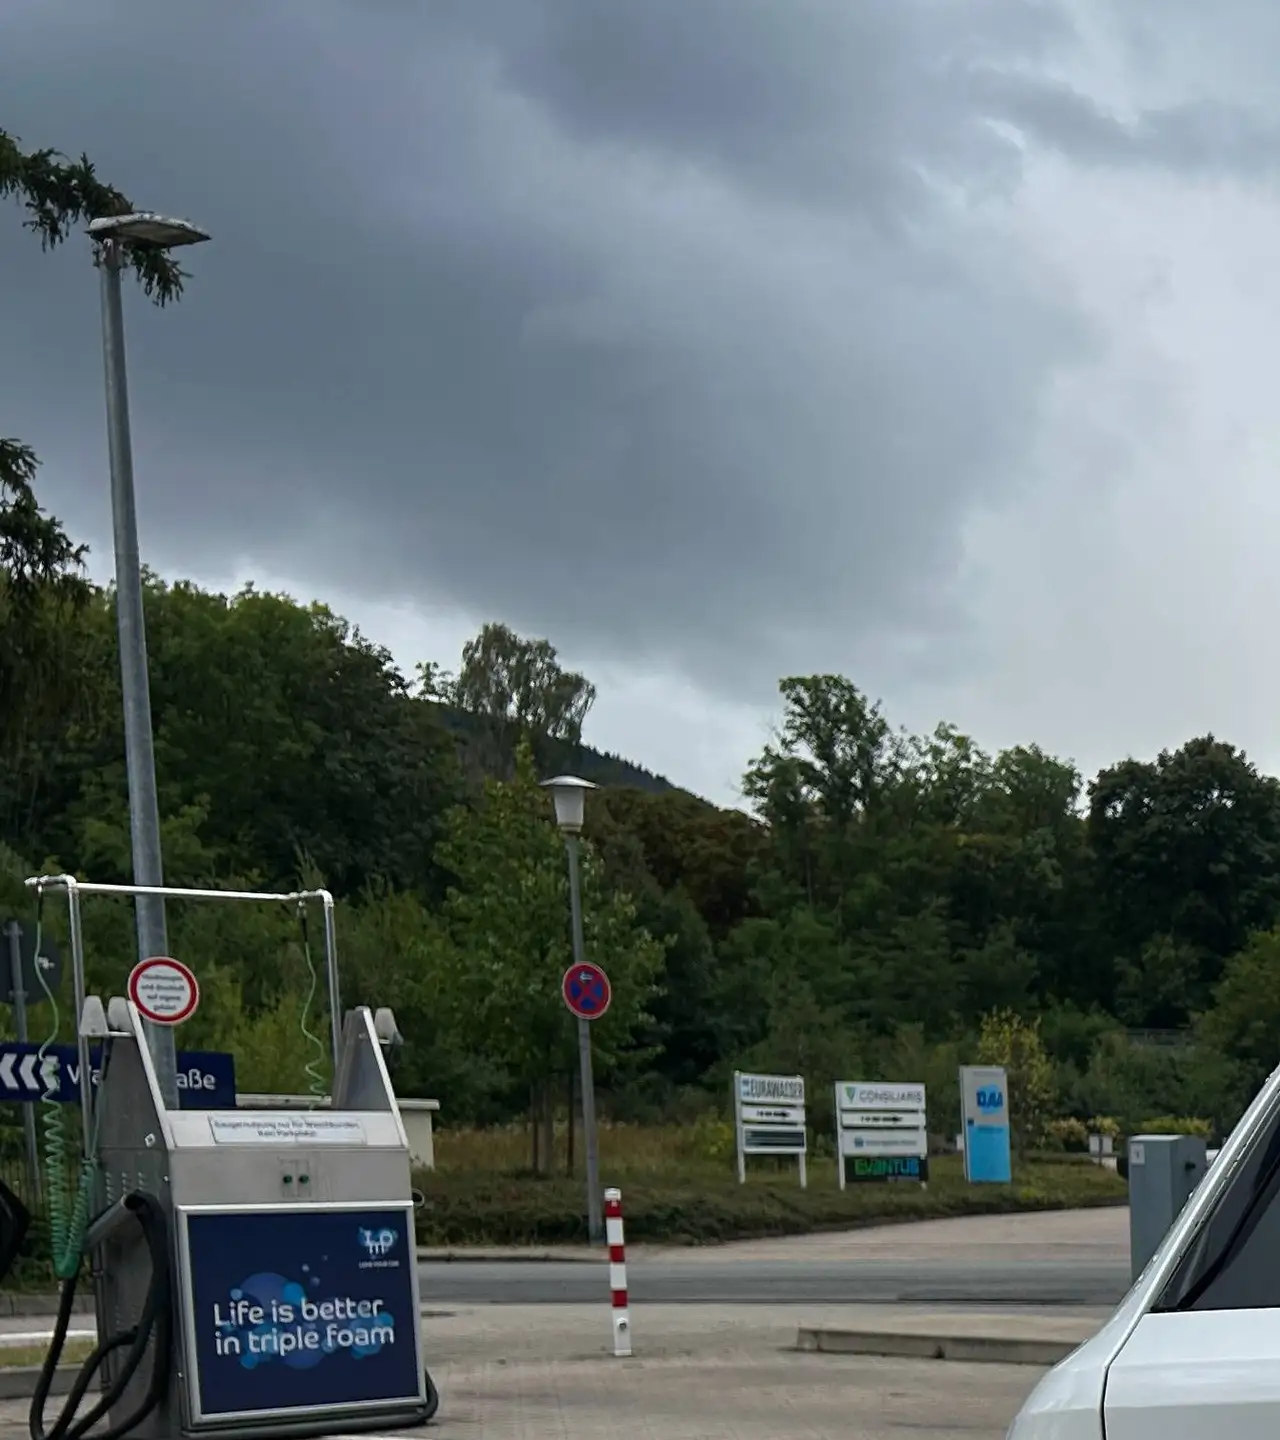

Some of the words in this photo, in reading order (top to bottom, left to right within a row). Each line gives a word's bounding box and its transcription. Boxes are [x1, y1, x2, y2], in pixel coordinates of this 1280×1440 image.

[214, 1300, 264, 1327] Life
[271, 1299, 294, 1324] is
[301, 1297, 384, 1321] better
[215, 1331, 241, 1356] in
[248, 1326, 320, 1356] triple
[326, 1323, 395, 1348] foam
